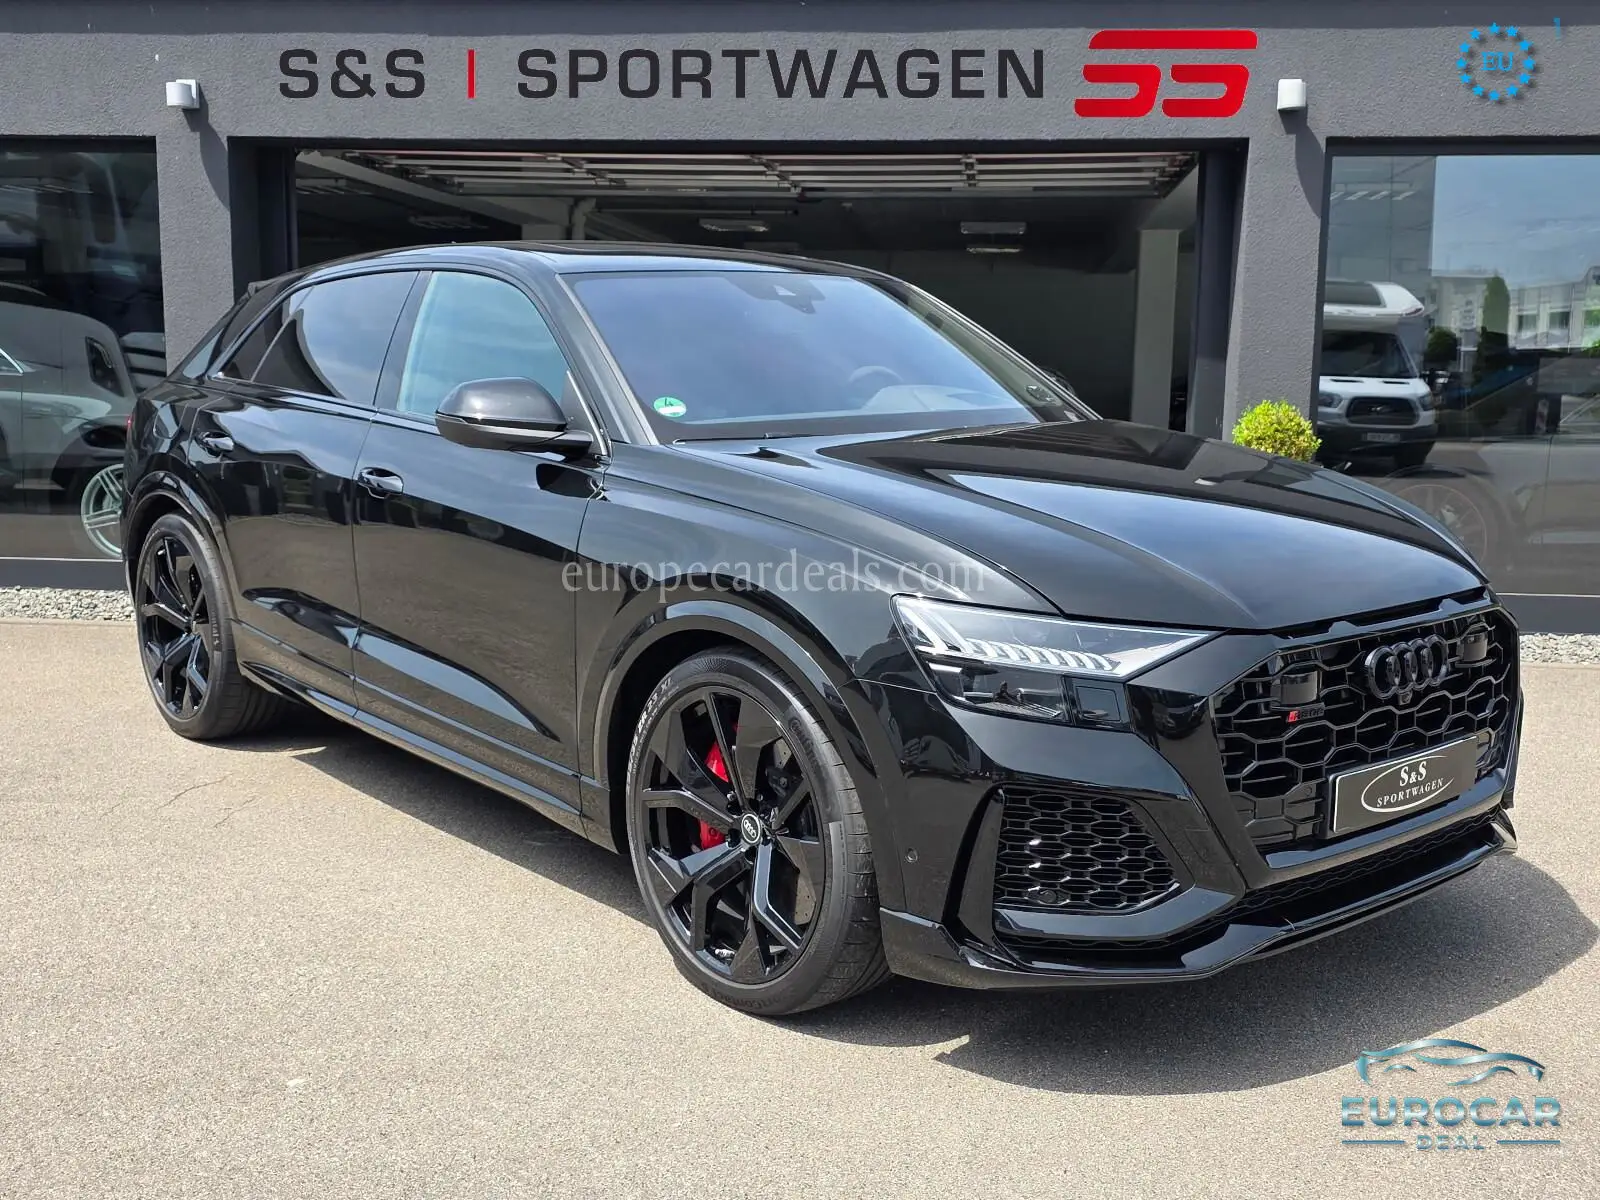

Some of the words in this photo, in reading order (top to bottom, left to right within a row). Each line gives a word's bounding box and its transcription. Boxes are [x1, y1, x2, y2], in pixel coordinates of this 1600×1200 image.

[279, 48, 425, 99] S&S
[517, 47, 1045, 99] SPORTWAGEN
[1400, 760, 1427, 787] S&S
[1376, 777, 1444, 808] SPORTWAGEN
